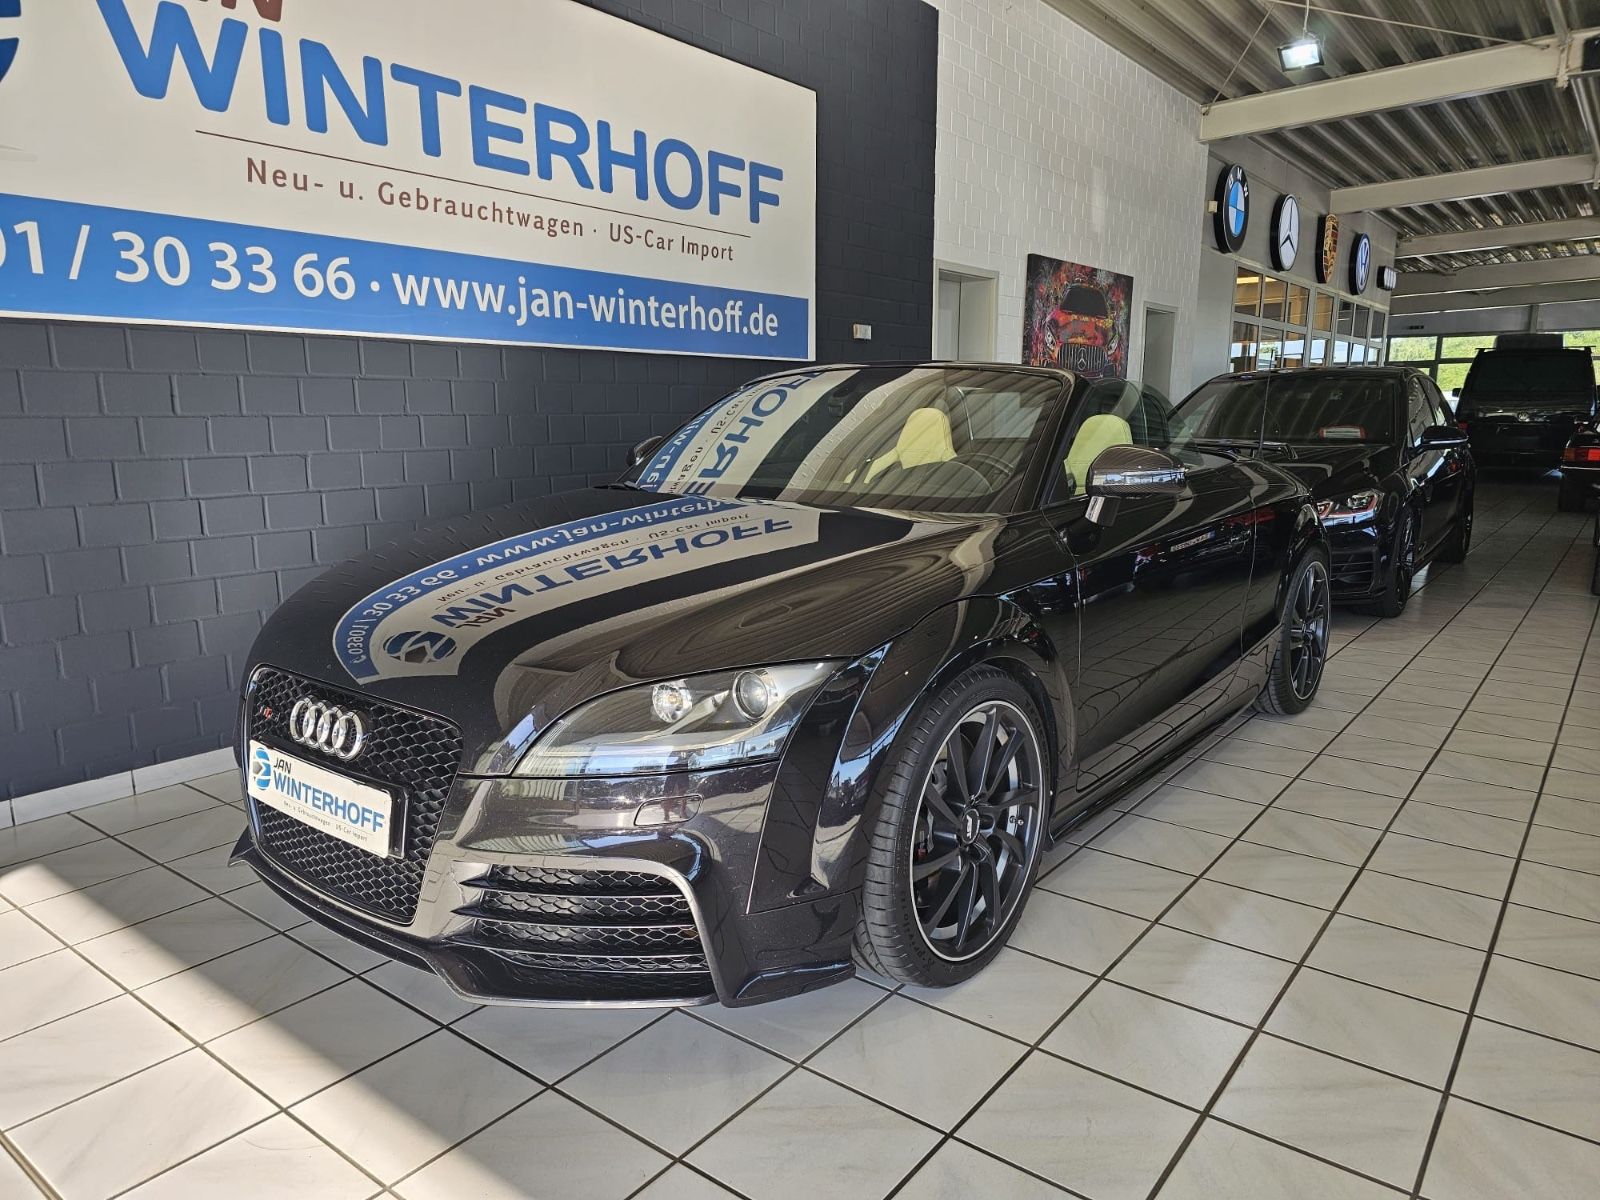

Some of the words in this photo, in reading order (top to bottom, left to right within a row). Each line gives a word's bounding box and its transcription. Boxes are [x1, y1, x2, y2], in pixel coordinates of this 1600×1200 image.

[96, 0, 784, 224] WINTERHOFF
[246, 157, 324, 191] Neu-
[339, 180, 364, 200] u.
[378, 181, 583, 237] Gebrauchtwagen
[609, 223, 674, 253] US-Car
[680, 235, 734, 262] Import
[0, 221, 44, 274] 1
[112, 231, 191, 286] 30
[208, 242, 277, 293] 33
[293, 253, 356, 300] 66
[392, 271, 778, 337] www.jan-winterhoff.de
[273, 770, 385, 832] WINTERHOFF
[274, 757, 292, 774] JAN
